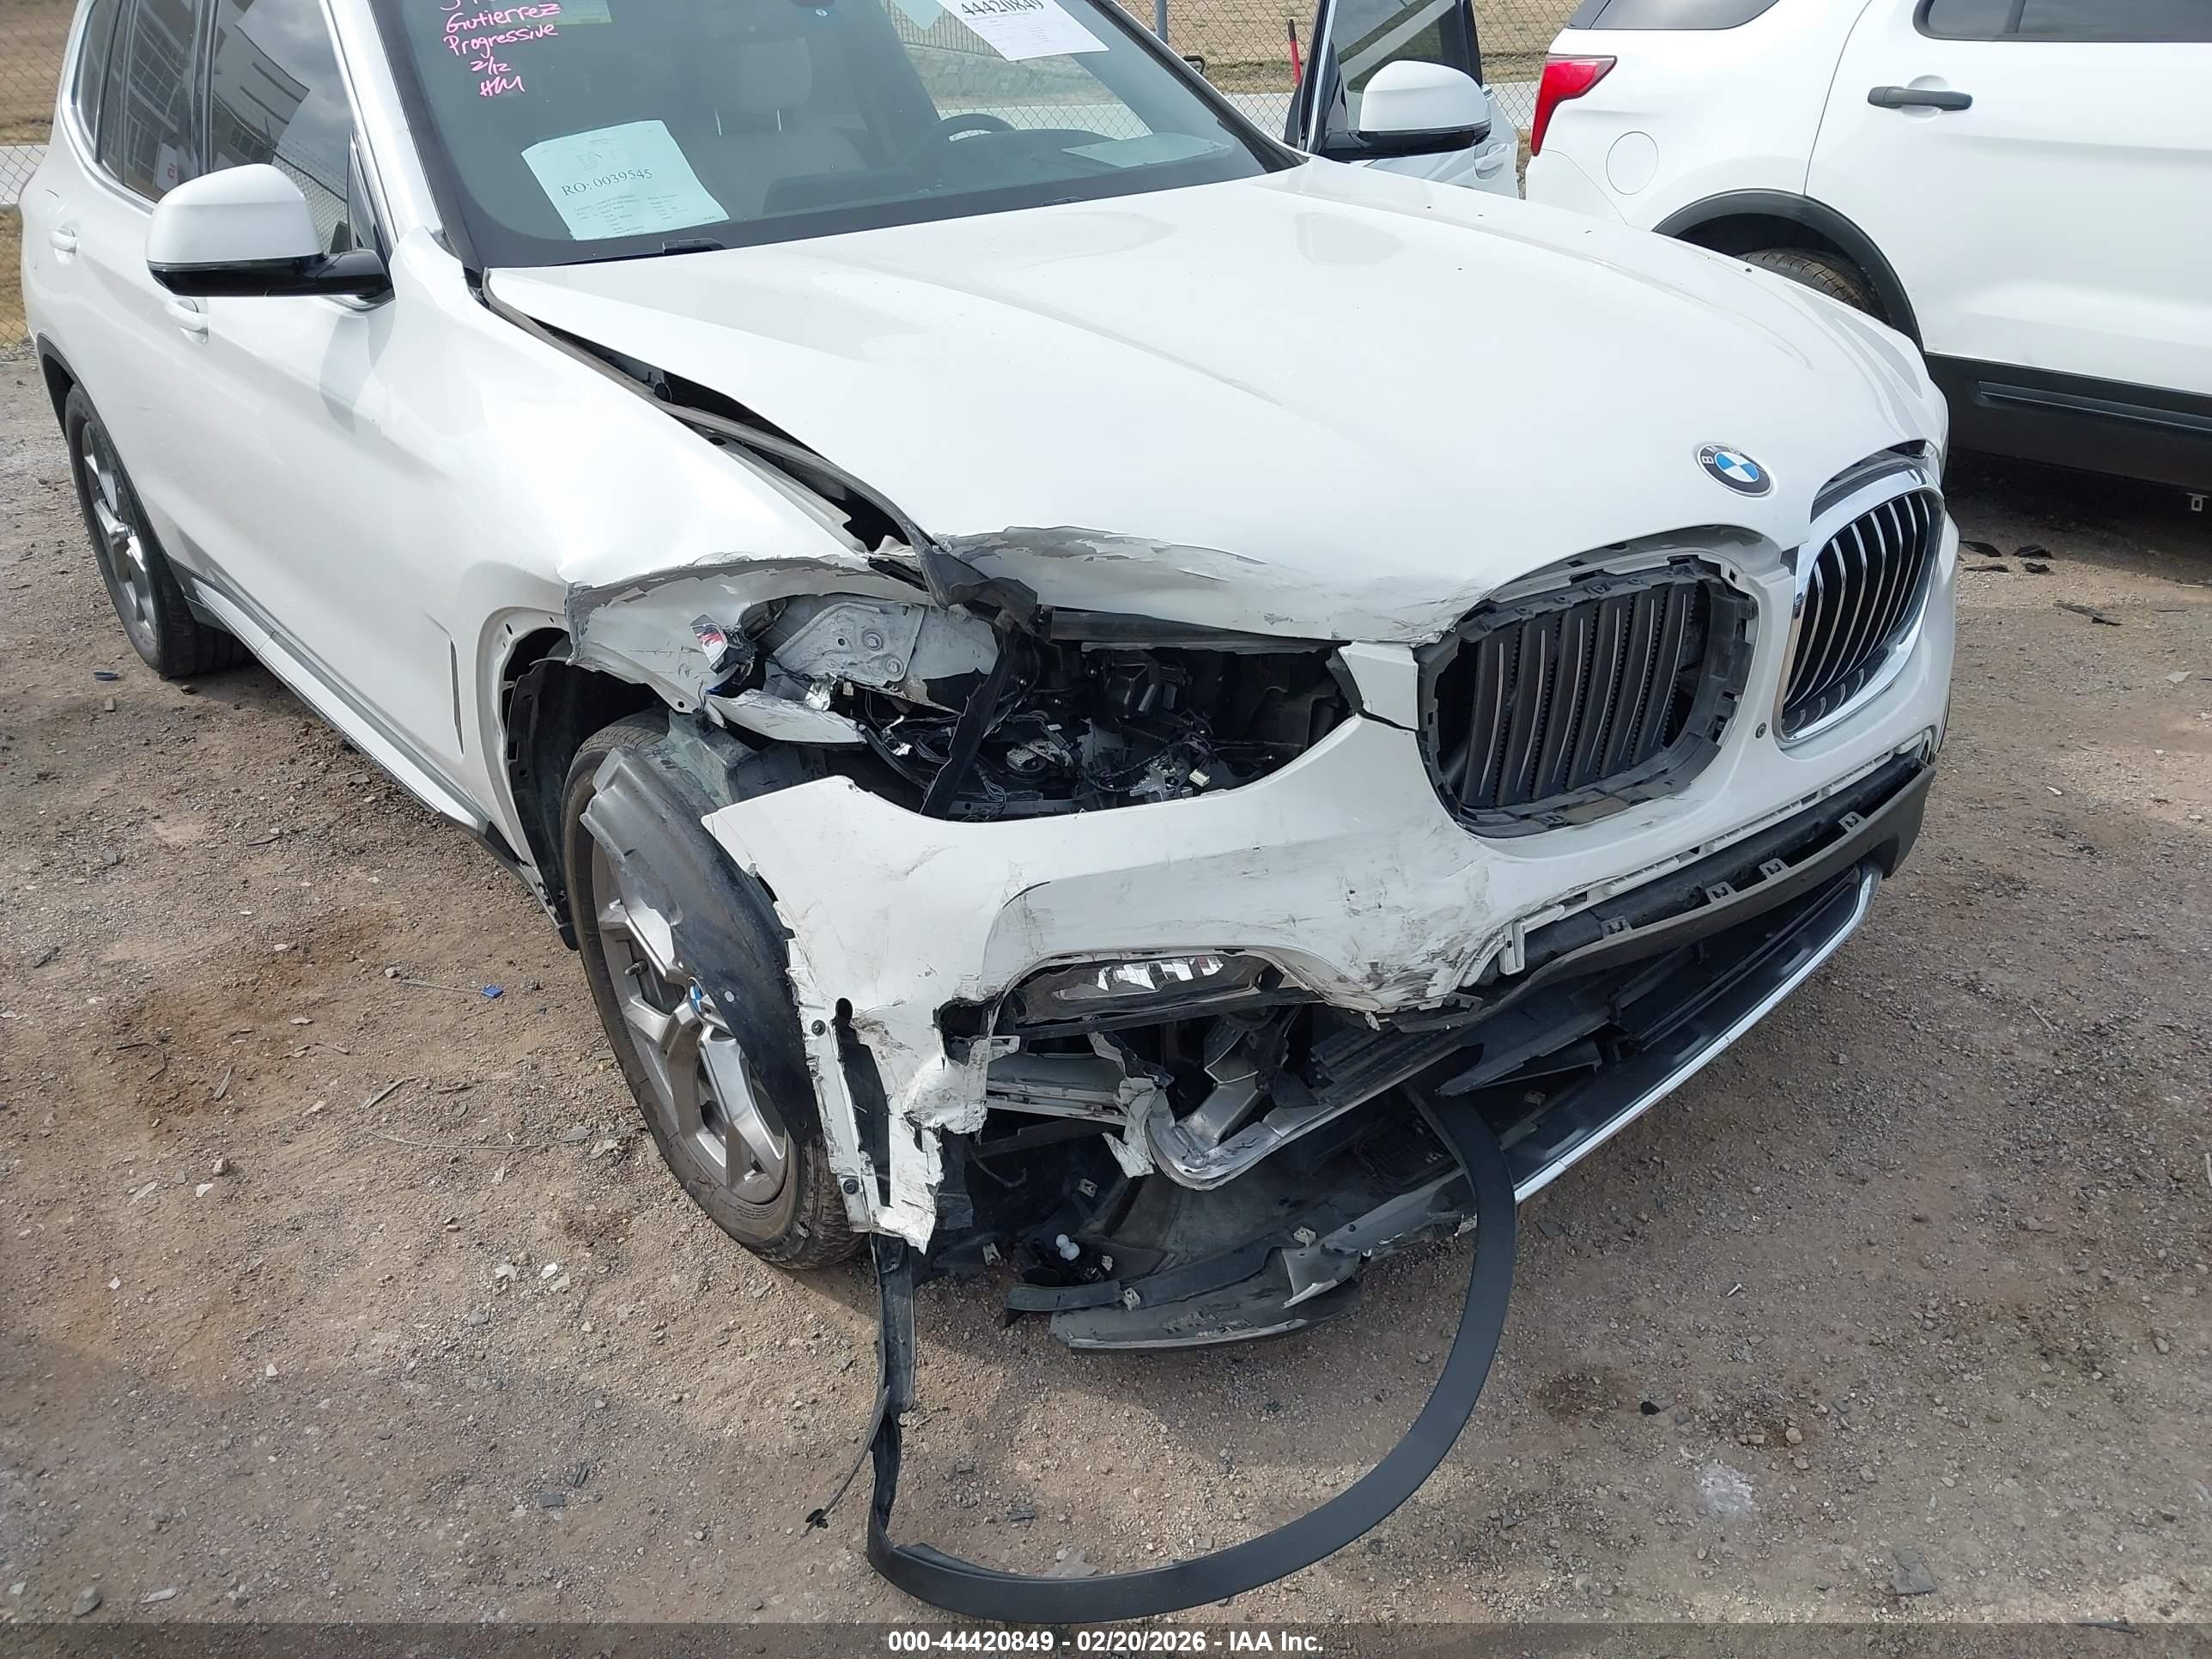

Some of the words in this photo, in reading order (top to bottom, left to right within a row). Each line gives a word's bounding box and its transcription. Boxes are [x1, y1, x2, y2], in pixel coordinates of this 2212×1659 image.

[446, 3, 561, 33] Gutierrez
[443, 23, 558, 59] Progressive
[470, 56, 512, 76] 2/12
[561, 181, 592, 197] RO:
[592, 168, 653, 188] 0039545
